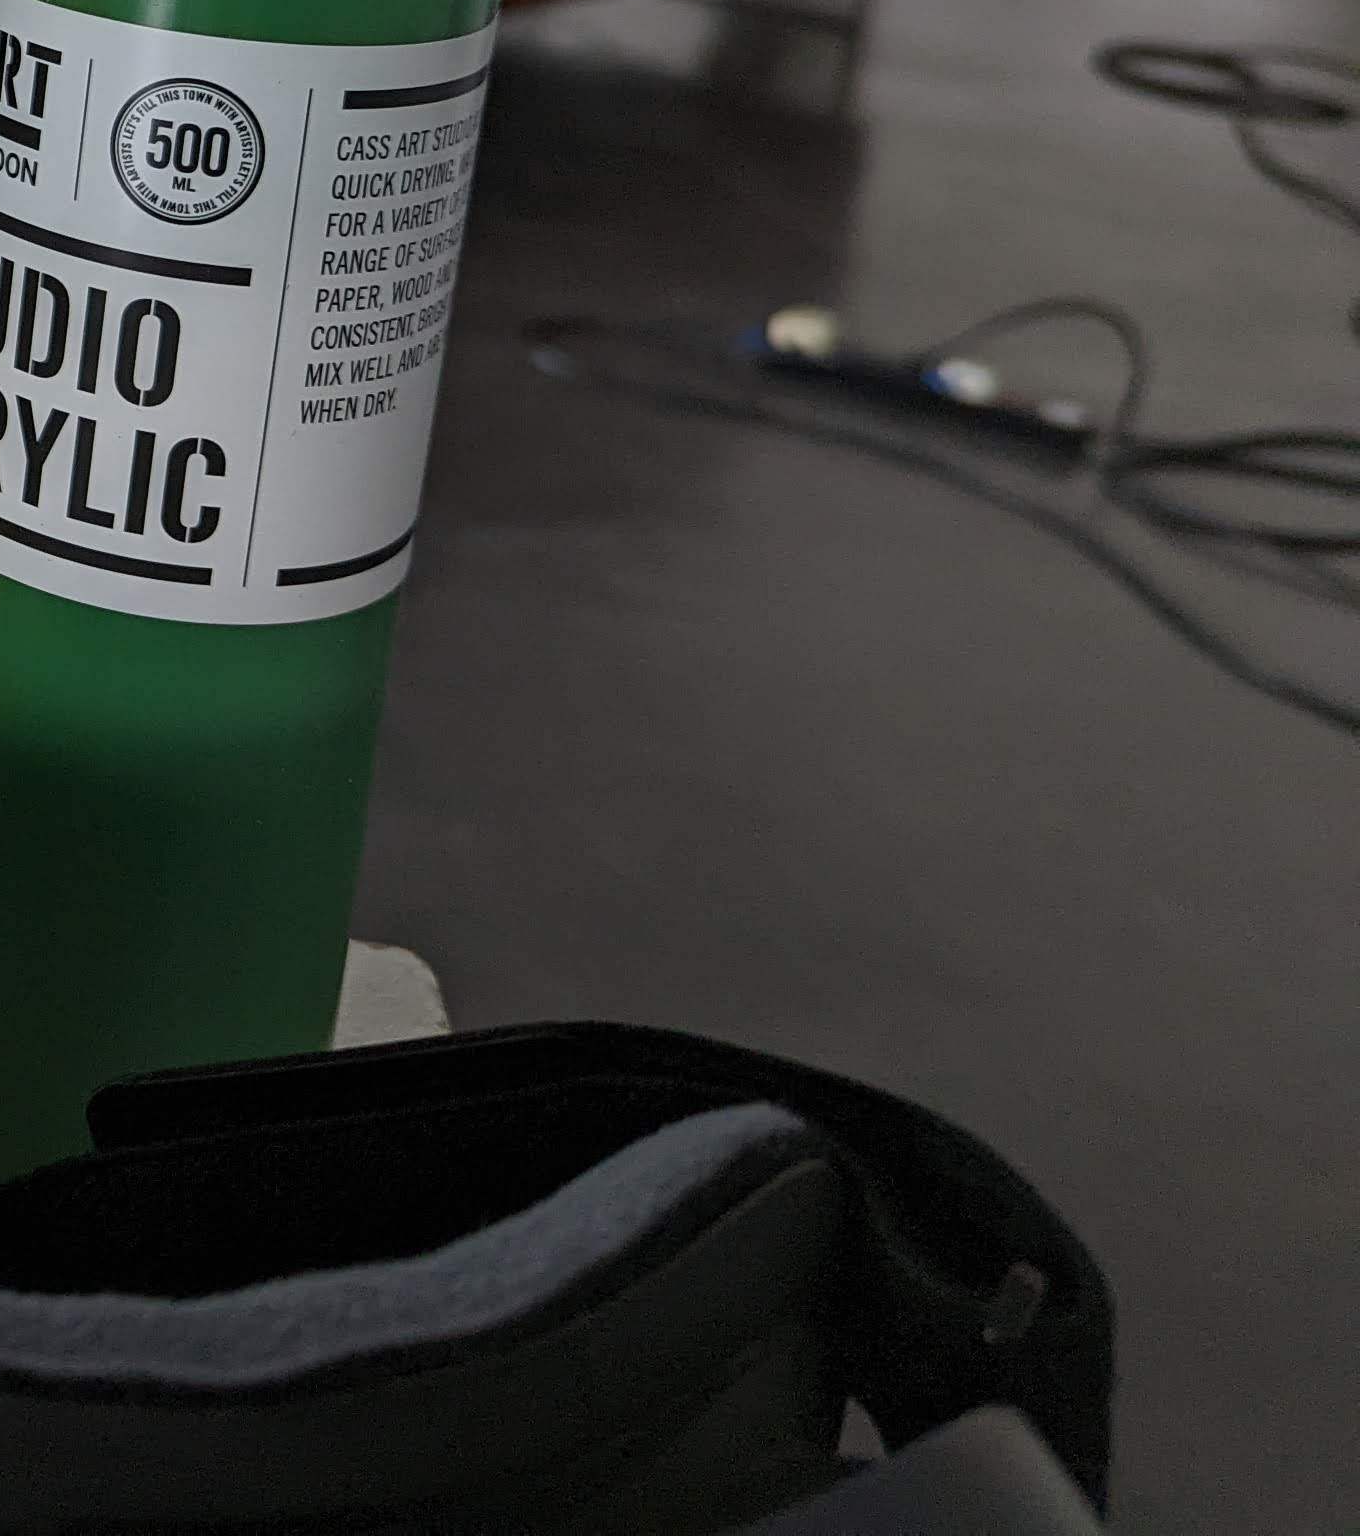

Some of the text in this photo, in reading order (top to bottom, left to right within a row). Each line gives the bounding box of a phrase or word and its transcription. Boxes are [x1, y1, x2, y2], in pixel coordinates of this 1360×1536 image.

[121, 89, 253, 214] LET'S FILL THIS TOWN WITH ARTISTS LET'S FILL THIS TOWN WITH ARTISTS
[146, 119, 230, 177] 500
[337, 135, 390, 161] CASS
[396, 130, 431, 158] ART
[172, 176, 196, 192] ML
[332, 172, 397, 200] QUICK
[401, 158, 456, 195] DRYING,
[326, 210, 367, 238] FOR
[372, 210, 384, 234] A
[392, 196, 447, 233] VARIETY
[320, 246, 390, 276] RANGE
[395, 241, 417, 268] OF
[315, 284, 384, 313] PAPER,
[392, 271, 432, 303] WOOD
[305, 361, 343, 388] MIX
[350, 350, 393, 383] WELL
[397, 341, 424, 373] AND
[300, 387, 397, 424] WHEN DRY.
